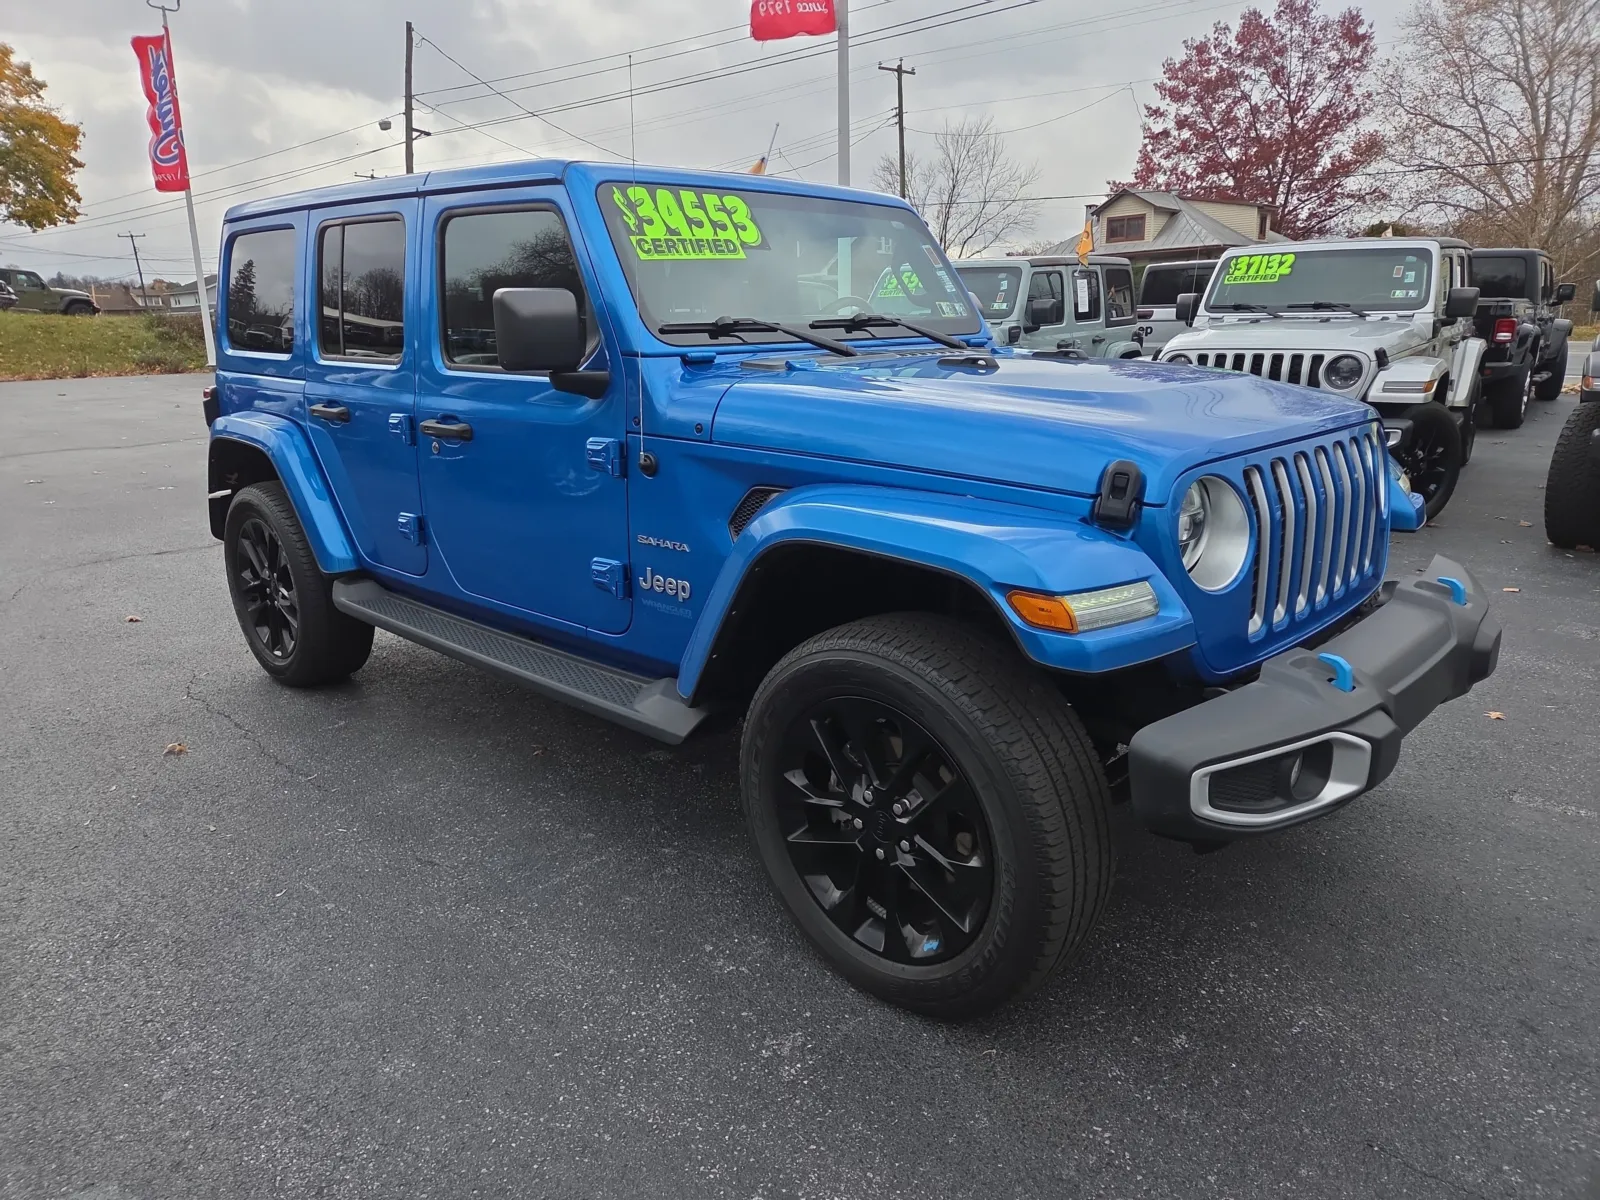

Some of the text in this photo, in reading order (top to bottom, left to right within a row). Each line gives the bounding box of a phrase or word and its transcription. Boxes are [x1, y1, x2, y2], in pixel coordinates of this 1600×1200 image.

[613, 186, 762, 247] $34553
[637, 238, 740, 256] CERTIFIED
[1229, 254, 1296, 275] $37132
[1226, 273, 1278, 283] CERTIFIED
[1138, 326, 1153, 337] ep
[637, 534, 690, 552] SAHARA
[638, 567, 690, 602] Jeep
